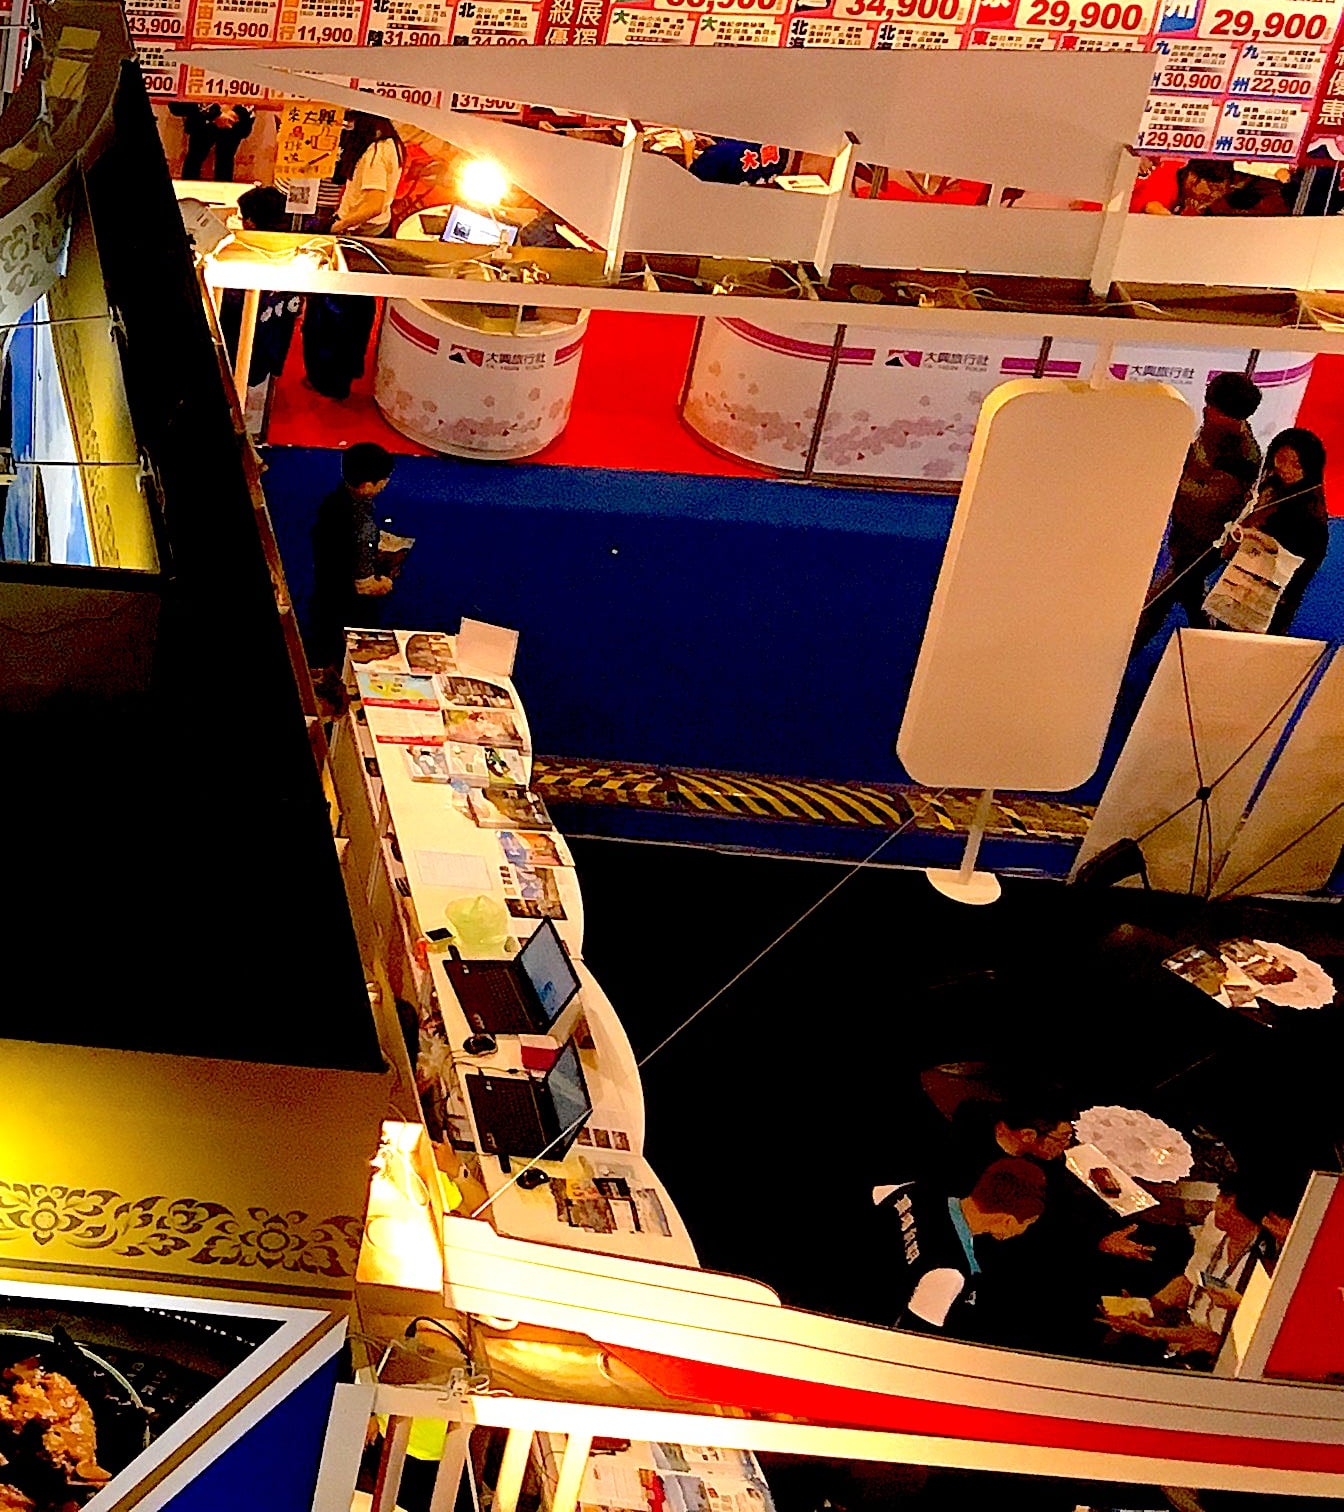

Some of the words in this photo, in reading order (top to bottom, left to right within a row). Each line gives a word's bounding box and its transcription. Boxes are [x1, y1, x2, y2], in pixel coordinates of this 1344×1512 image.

[1027, 0, 1143, 31] 29,900
[213, 20, 269, 38] 15,900
[298, 24, 354, 44] 11,900
[1209, 9, 1327, 41] 29,900
[1162, 72, 1222, 91] 30,900
[1251, 78, 1312, 96] 22,900
[1145, 132, 1206, 150] 29,900
[1232, 138, 1294, 155] 30,900
